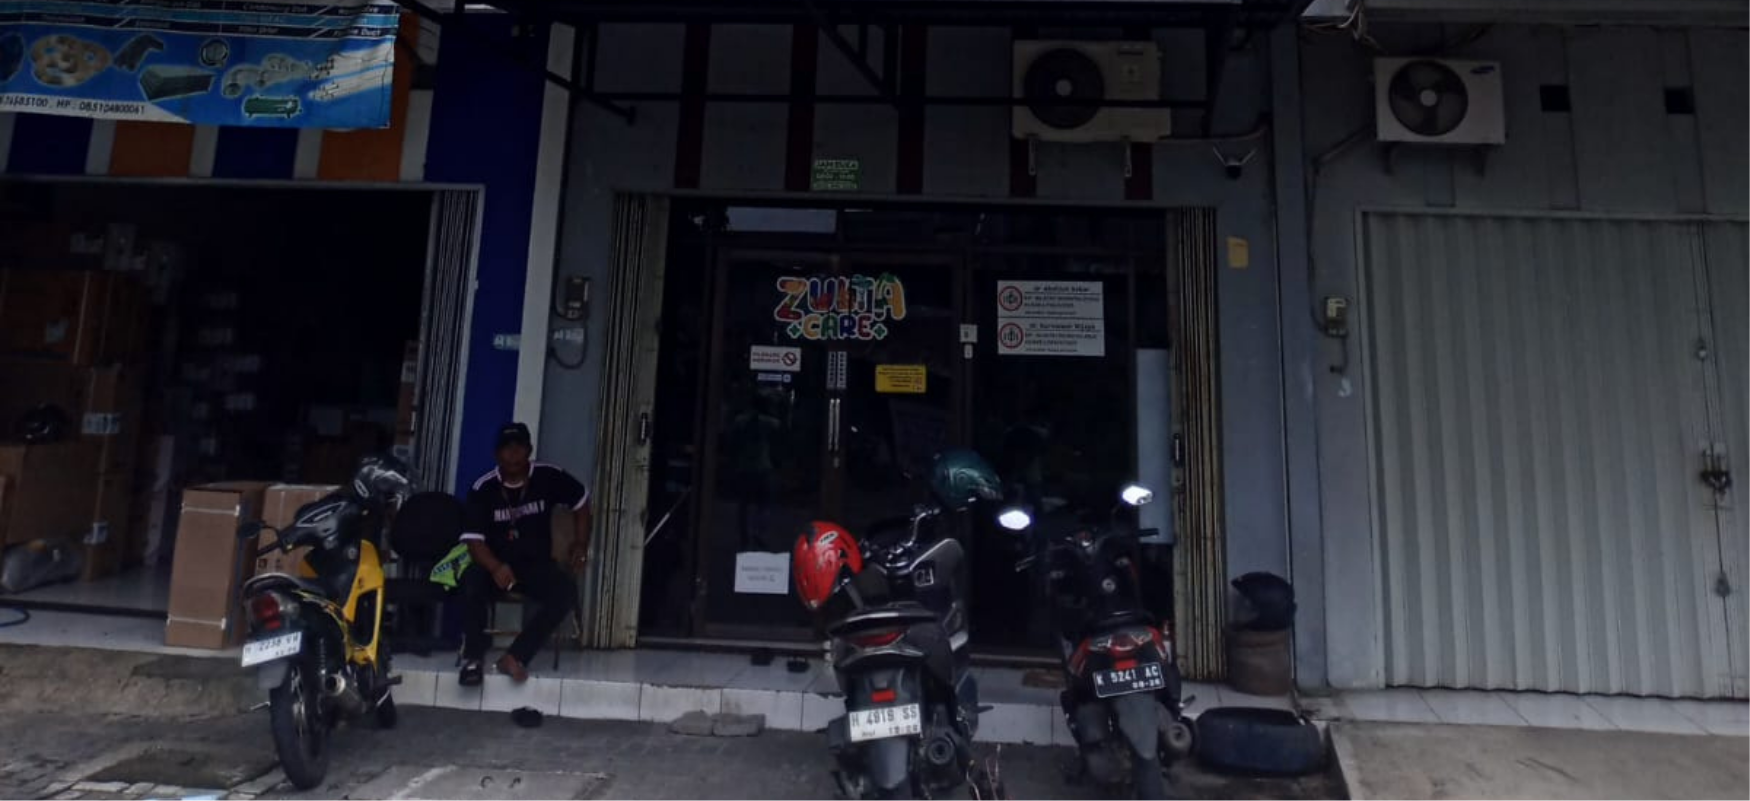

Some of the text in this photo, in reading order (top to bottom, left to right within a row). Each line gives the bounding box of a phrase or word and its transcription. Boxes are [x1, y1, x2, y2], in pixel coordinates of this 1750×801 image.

[801, 312, 874, 340] CARE
[1096, 675, 1105, 686] K
[1145, 665, 1159, 678] AC
